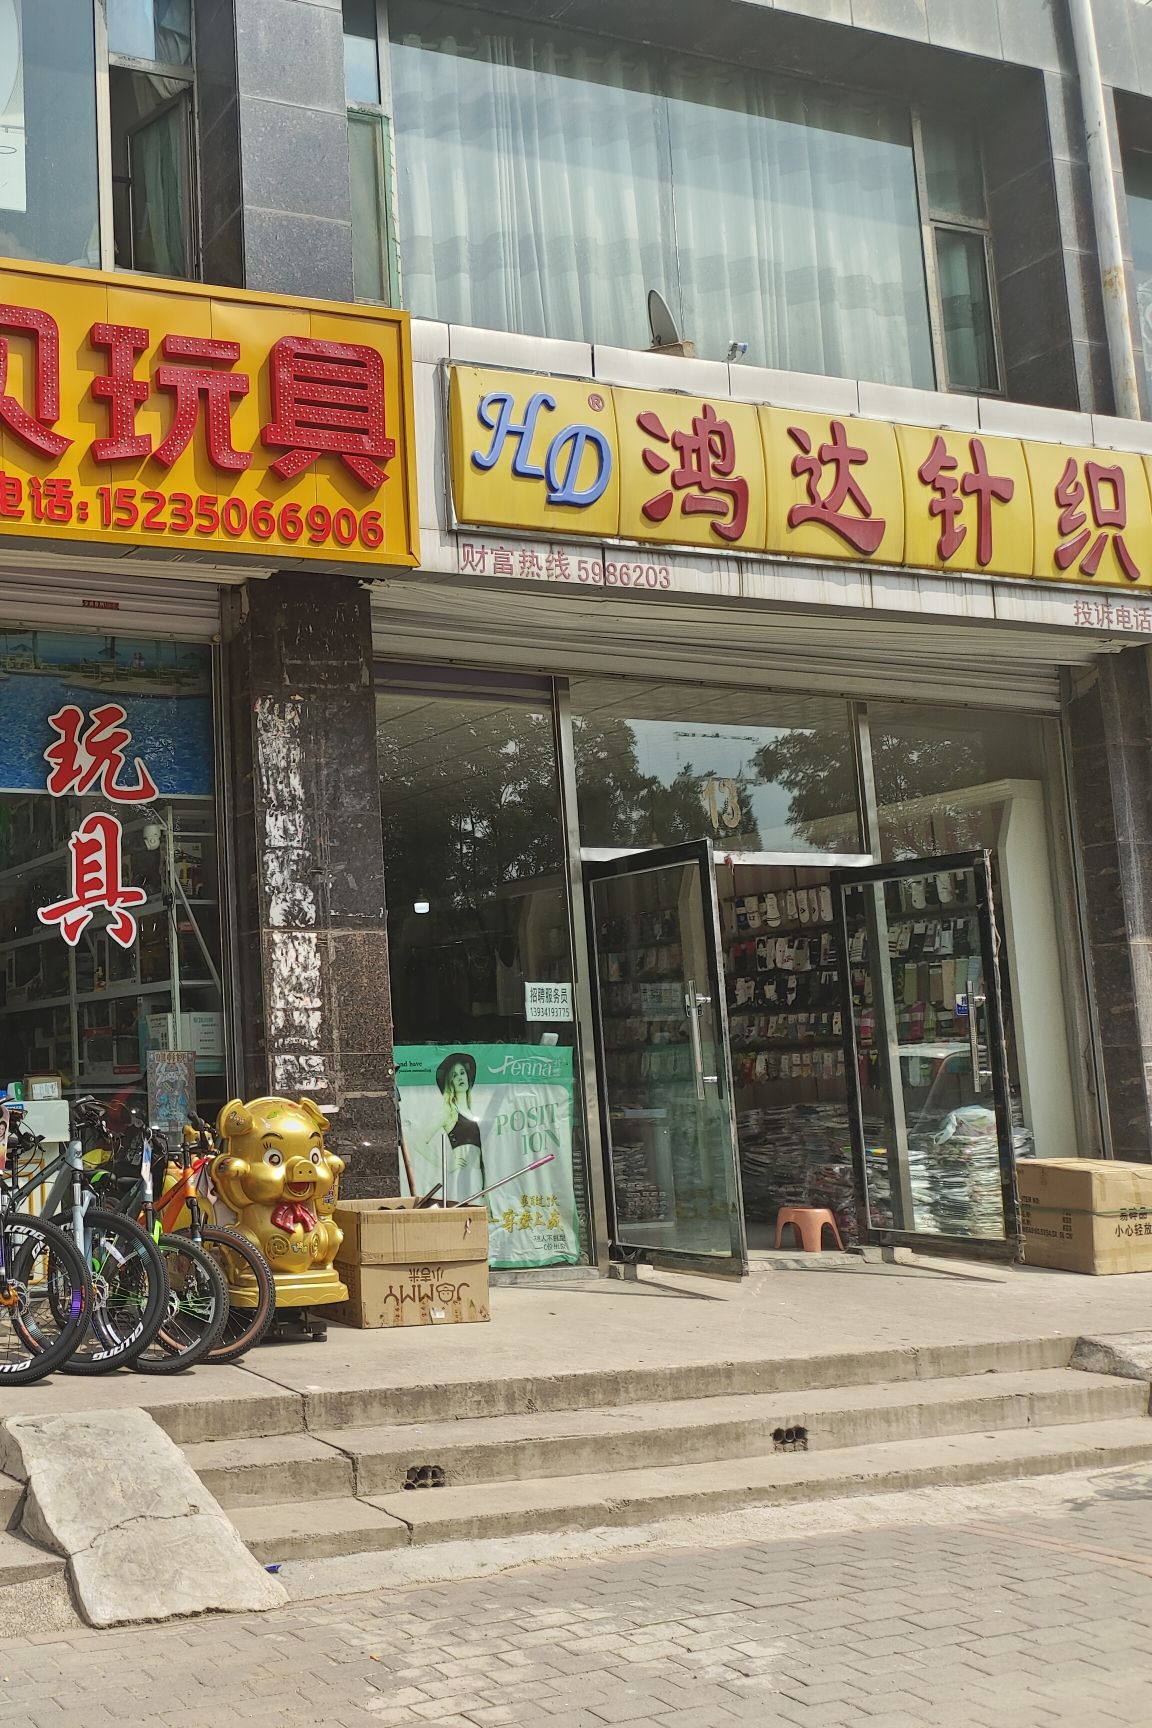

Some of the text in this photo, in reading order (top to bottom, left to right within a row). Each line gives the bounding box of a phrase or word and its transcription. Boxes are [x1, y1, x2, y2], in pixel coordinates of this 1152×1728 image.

[636, 404, 1139, 580] 鸿达针织
[1073, 600, 1152, 632] 投诉电话
[37, 703, 159, 949] 玩具
[529, 987, 568, 1004] 招聘服务员
[496, 1103, 559, 1136] POSIT
[522, 1129, 561, 1156] ION
[1115, 1223, 1152, 1238] 小心轻放
